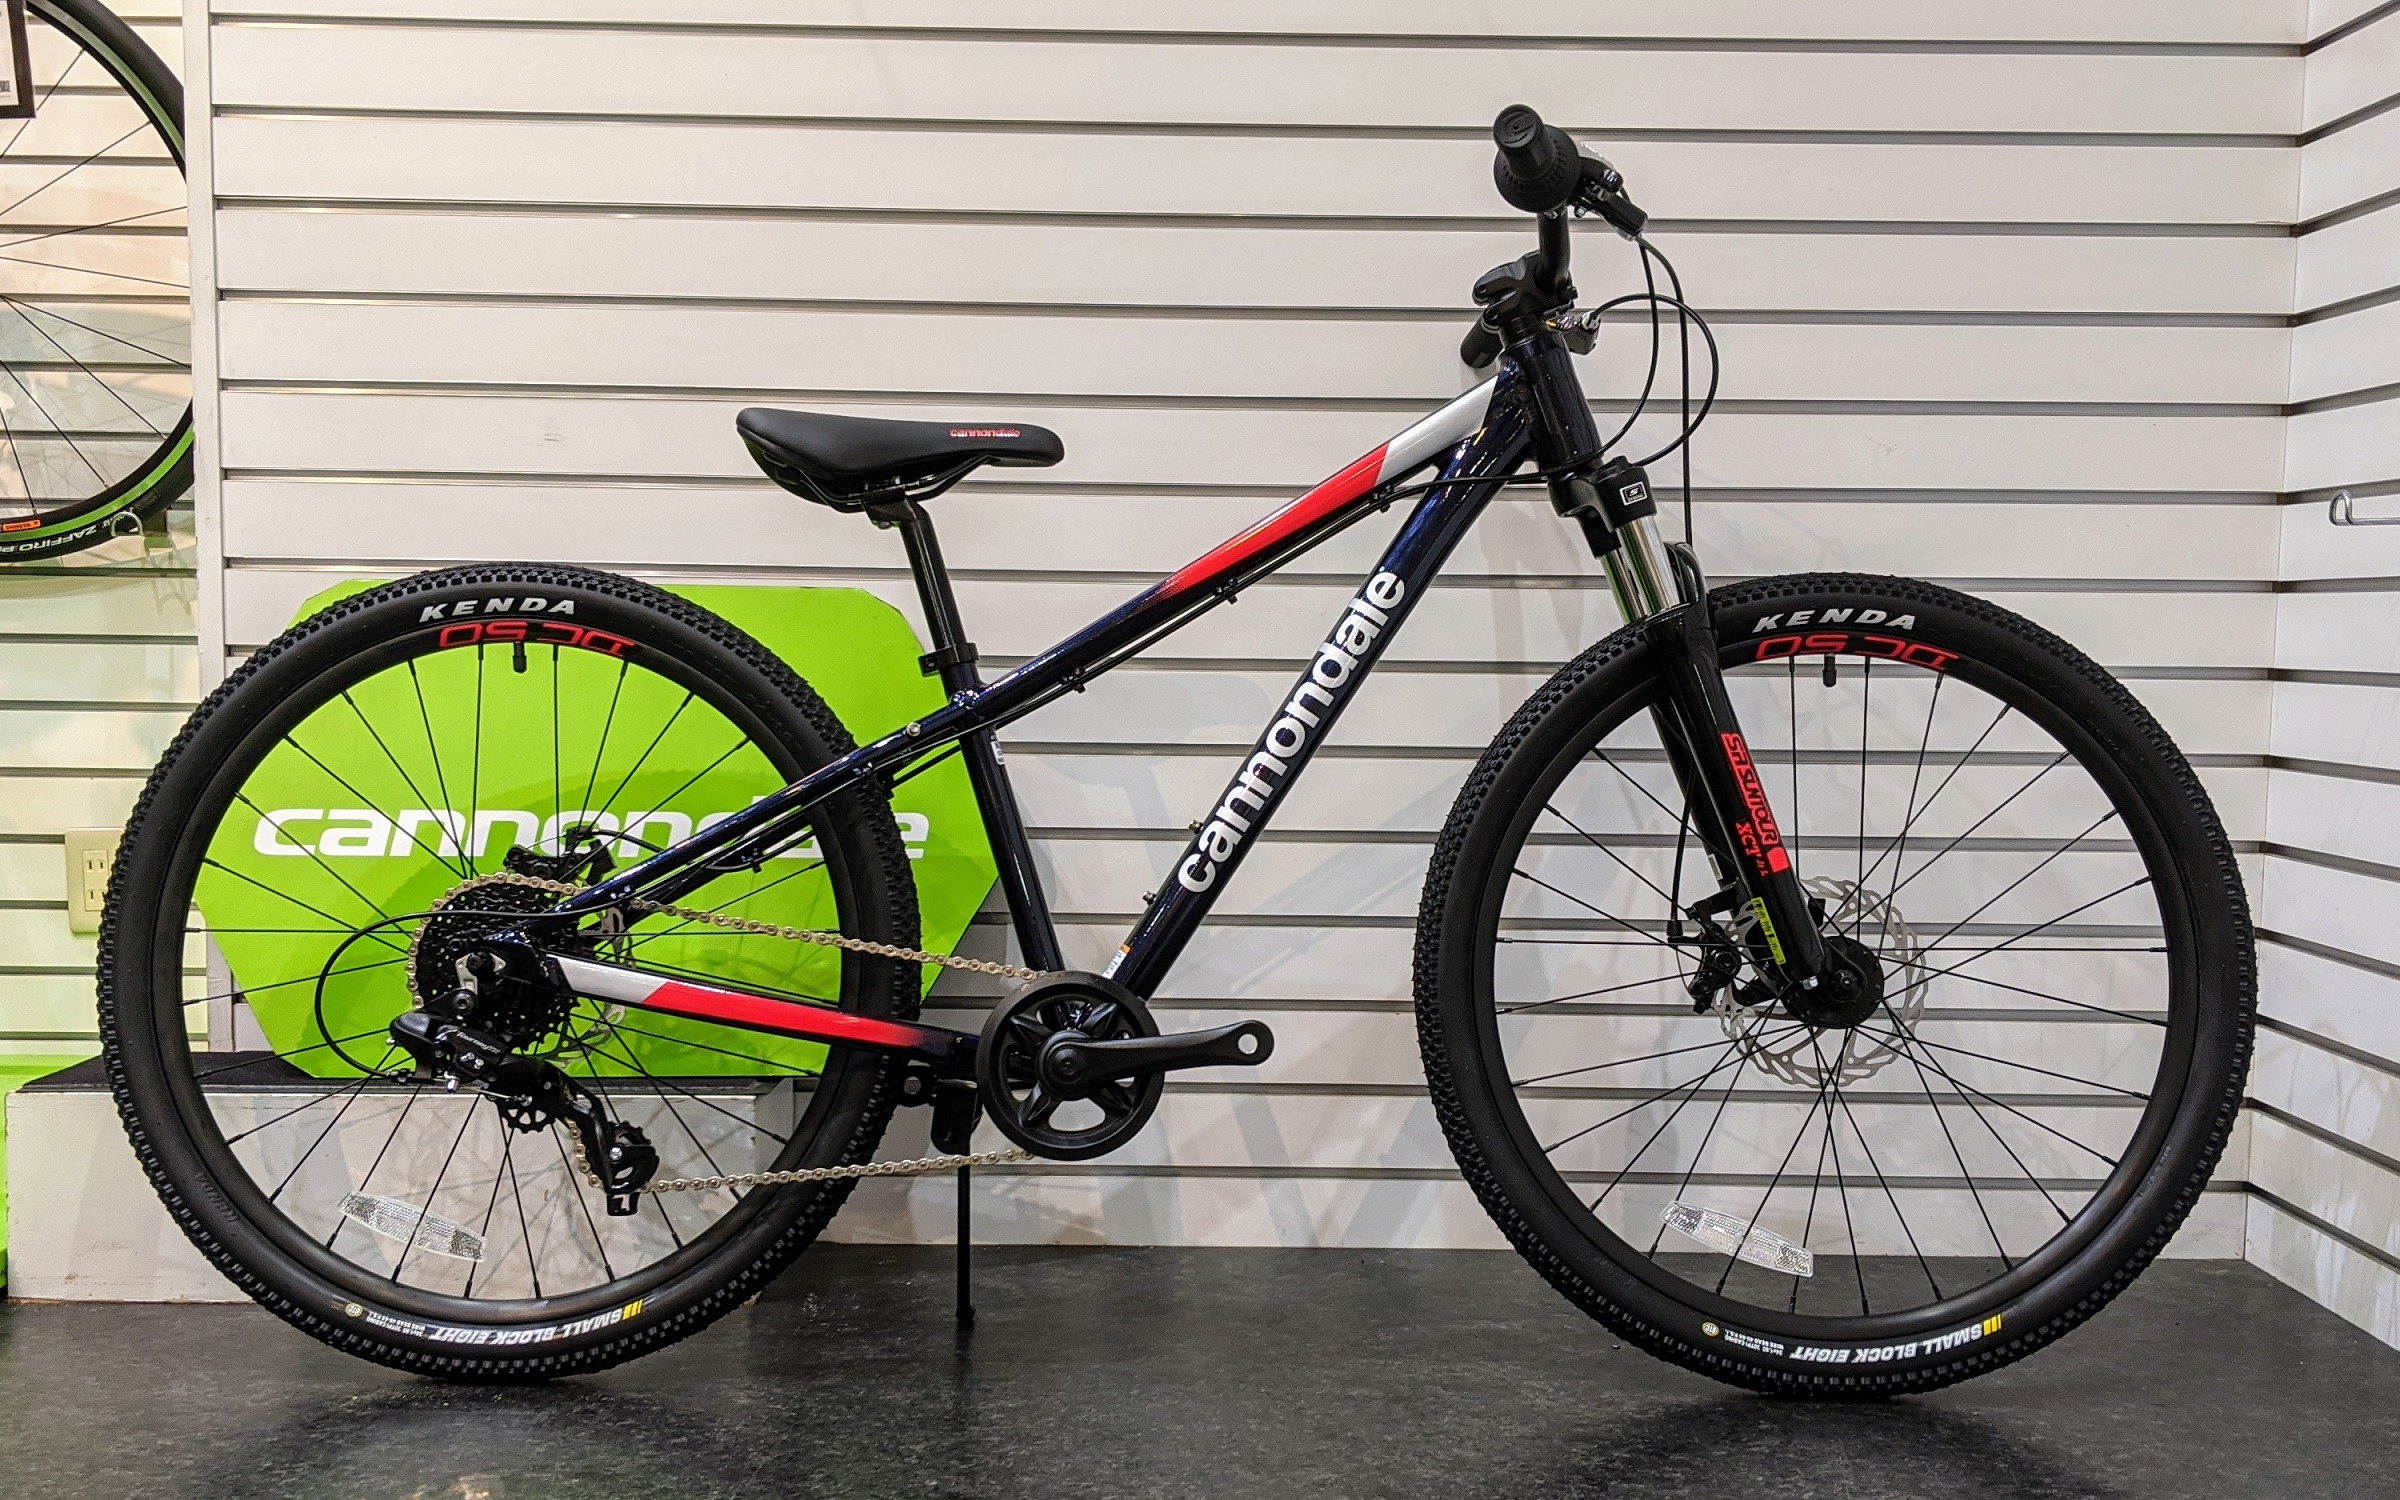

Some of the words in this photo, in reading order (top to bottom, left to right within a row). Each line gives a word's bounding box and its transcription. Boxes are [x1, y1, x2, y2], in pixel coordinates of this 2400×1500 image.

[950, 427, 1021, 438] cannondale
[19, 525, 97, 551] ZAFFIRO
[420, 598, 575, 623] KENDA
[1752, 608, 1916, 634] KENDA
[1178, 570, 1406, 893] cannondale
[1738, 768, 1779, 845] SUNTOUR
[1736, 821, 1761, 857] XCT
[428, 1327, 491, 1345] EIGHT
[489, 1326, 558, 1346] BLOCK
[557, 1308, 624, 1339] SMALL
[1920, 1324, 1982, 1355] SMALL
[1789, 1346, 1851, 1364] EIGHT
[1851, 1342, 1918, 1364] BLOCK
